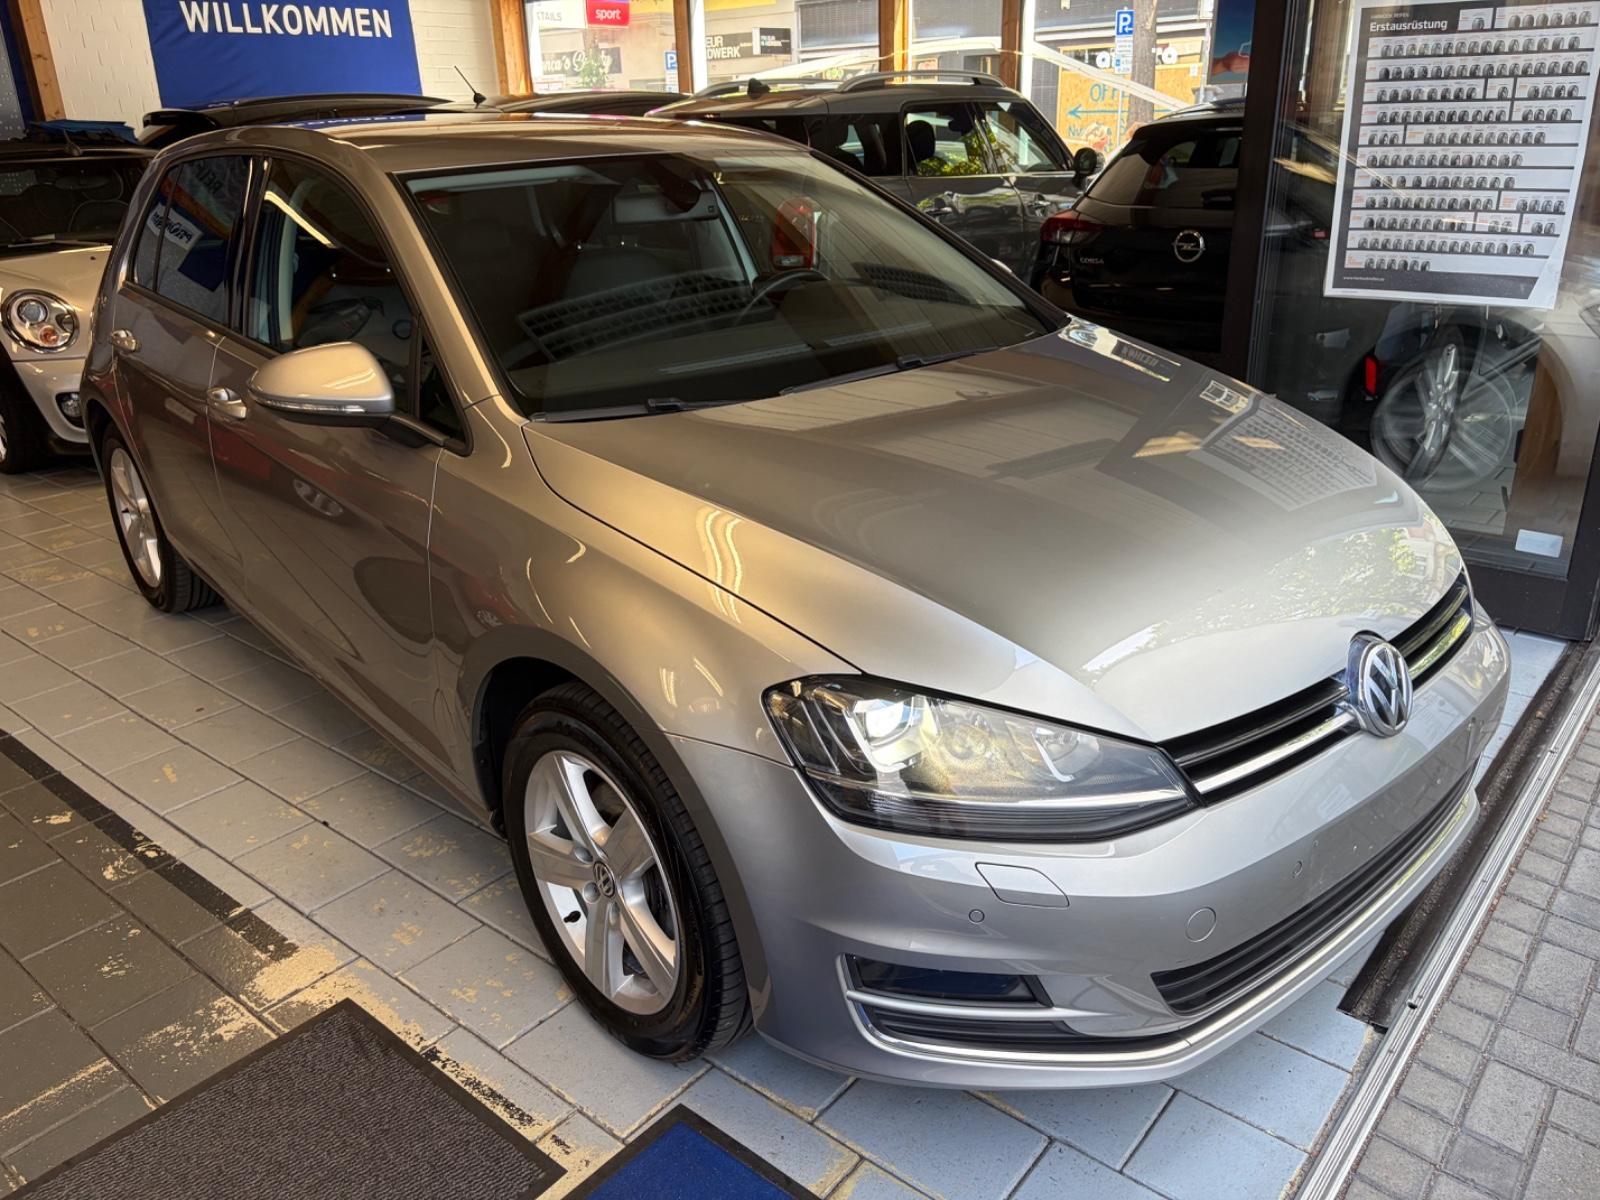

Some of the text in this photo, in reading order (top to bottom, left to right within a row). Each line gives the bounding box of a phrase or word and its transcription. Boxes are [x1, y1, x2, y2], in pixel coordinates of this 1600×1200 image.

[180, 1, 392, 38] WILLKOMMEN
[595, 9, 621, 21] sport
[1119, 13, 1132, 33] P
[1369, 20, 1448, 32] Erstausrüstung
